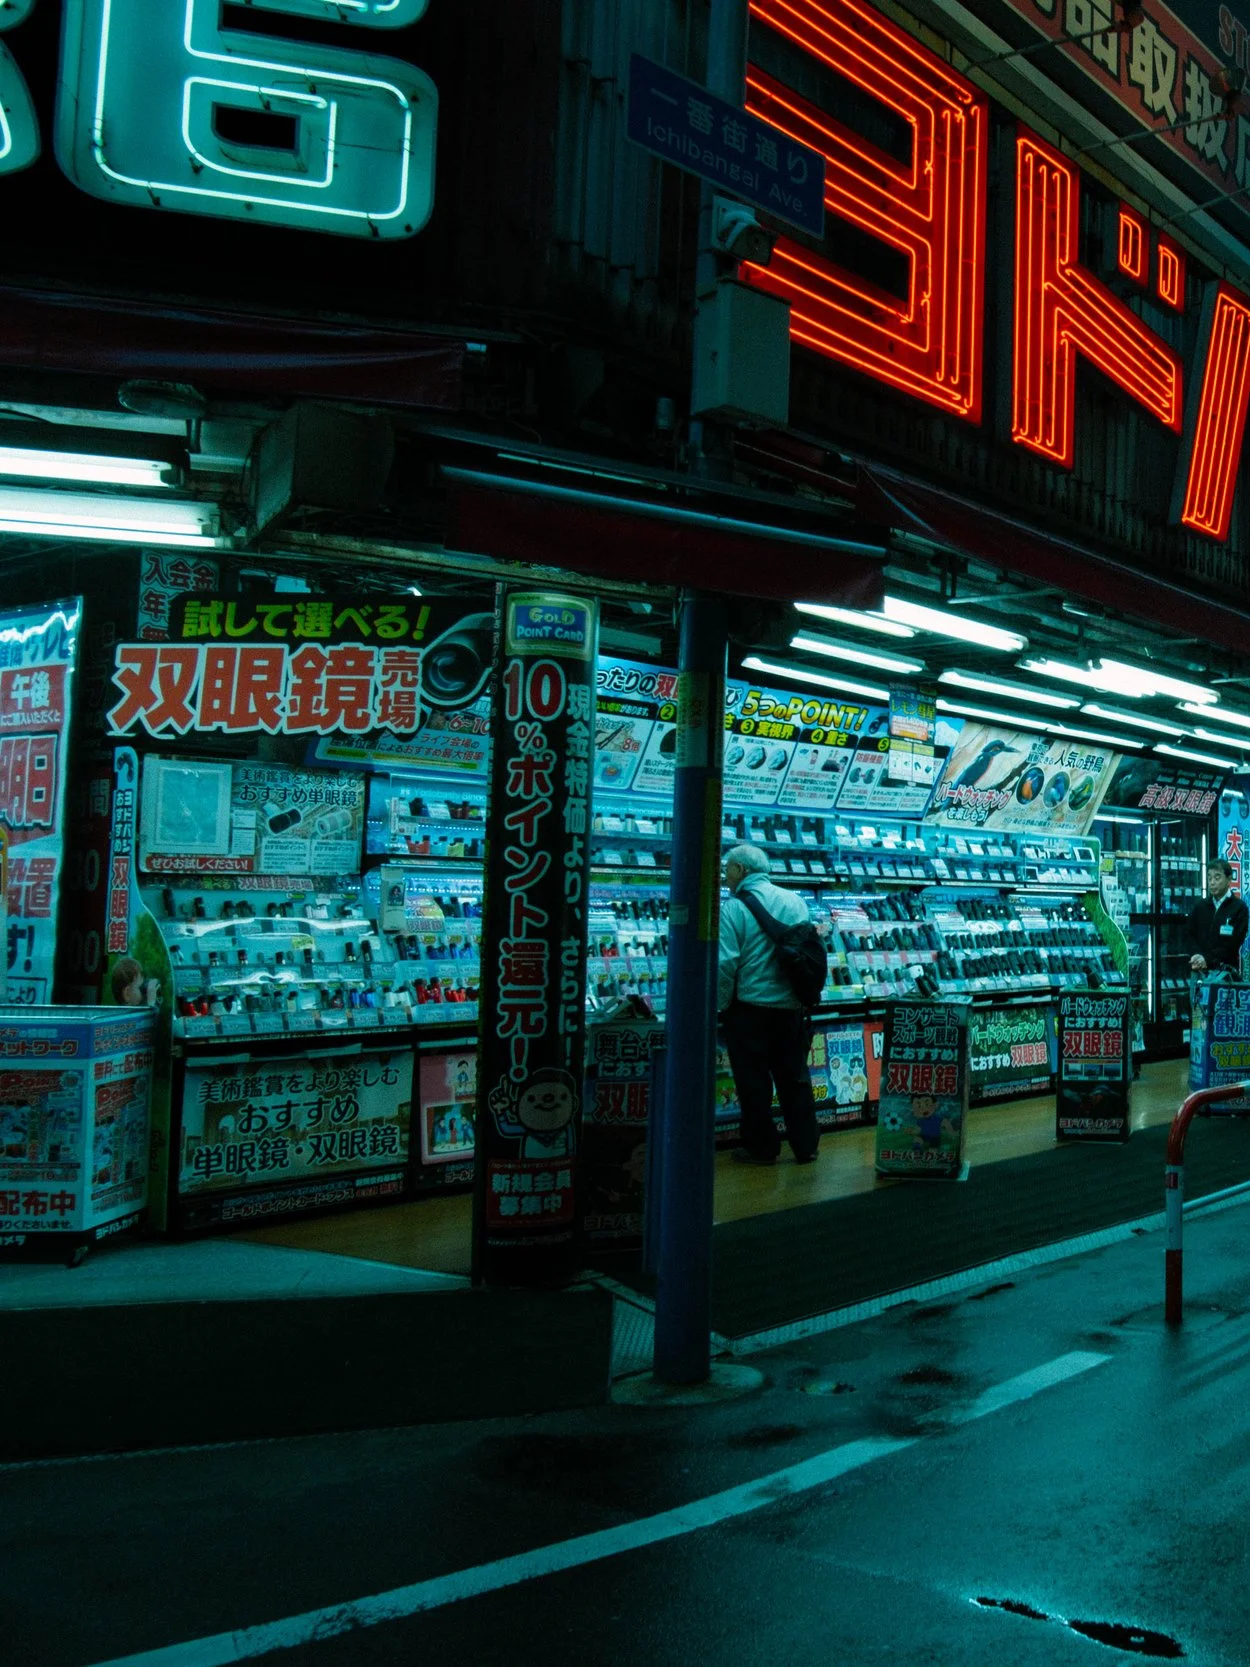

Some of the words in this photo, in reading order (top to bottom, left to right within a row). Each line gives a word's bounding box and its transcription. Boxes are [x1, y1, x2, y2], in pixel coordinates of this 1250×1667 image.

[645, 112, 762, 191] Ichibangai
[648, 90, 812, 187] 一番街通り
[181, 600, 432, 640] 試して選べる!
[528, 607, 575, 625] GOLD
[516, 624, 551, 639] POINT
[554, 626, 585, 643] CARD
[11, 670, 50, 708] 午後
[107, 643, 422, 735] 双眼鏡売場
[756, 721, 795, 739] 実視界
[1054, 750, 1105, 773] 人気の野鳥
[239, 785, 359, 807] おすすめ単眼鏡
[1137, 783, 1218, 815] 高級双眼鏡
[150, 857, 249, 871] ぜひお試しください!
[108, 856, 130, 954] 双眼鏡
[894, 1007, 960, 1026] コンサート
[1061, 998, 1126, 1015] バードウォッチング
[892, 1026, 959, 1045] スポーツ観戦
[1065, 1017, 1122, 1029] におすすめ!
[890, 1047, 959, 1061] におすすめ!
[1010, 1041, 1048, 1068] 双眼鏡
[1062, 1030, 1123, 1057] 双眼鏡
[199, 1065, 400, 1102] 美術鑑賞をより楽しむ
[886, 1063, 959, 1096] 双眼鏡
[238, 1091, 360, 1134] おすすめ
[192, 1124, 400, 1179] 単眼鏡・双眼鏡
